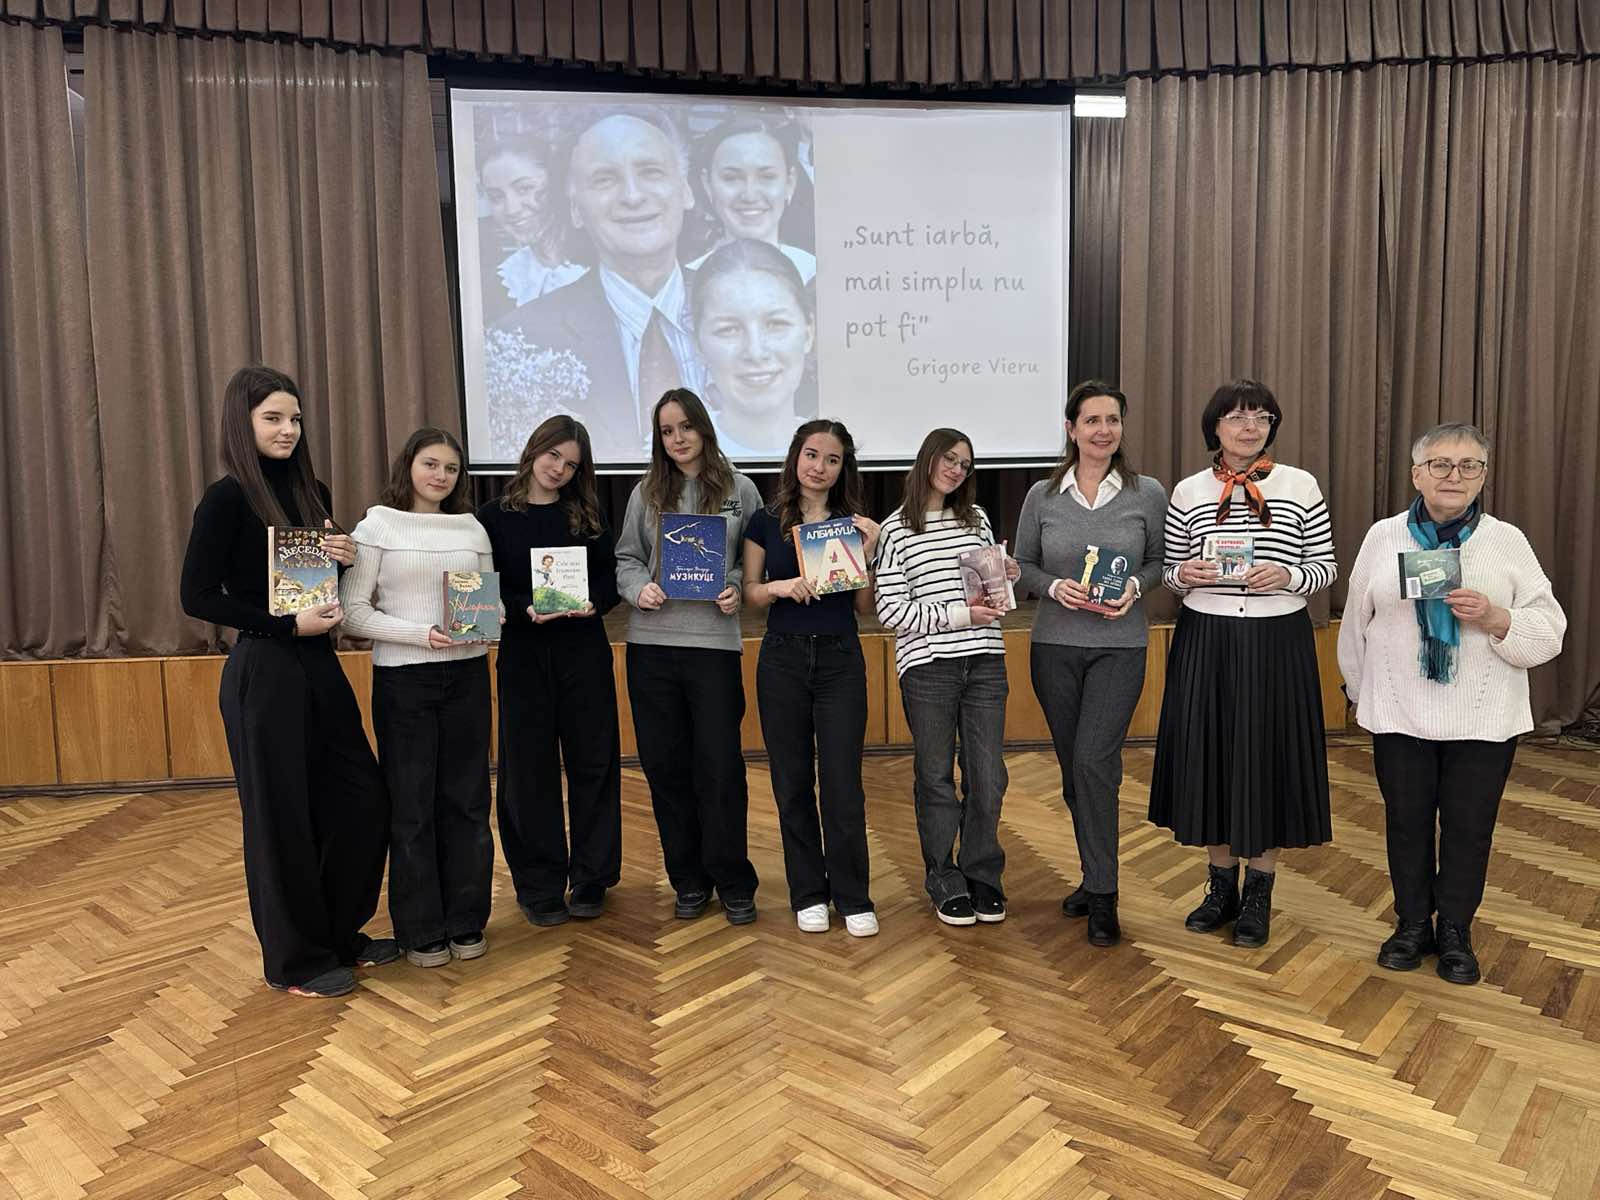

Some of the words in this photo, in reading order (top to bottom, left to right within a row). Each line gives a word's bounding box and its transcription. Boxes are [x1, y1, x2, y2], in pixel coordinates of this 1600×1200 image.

[926, 220, 1000, 249] iarbă,
[845, 271, 891, 292] mai
[902, 267, 984, 303] simplu
[994, 277, 1026, 292] nu
[846, 314, 888, 349] pot
[907, 358, 982, 383] Grigore
[988, 358, 1040, 375] Vieru
